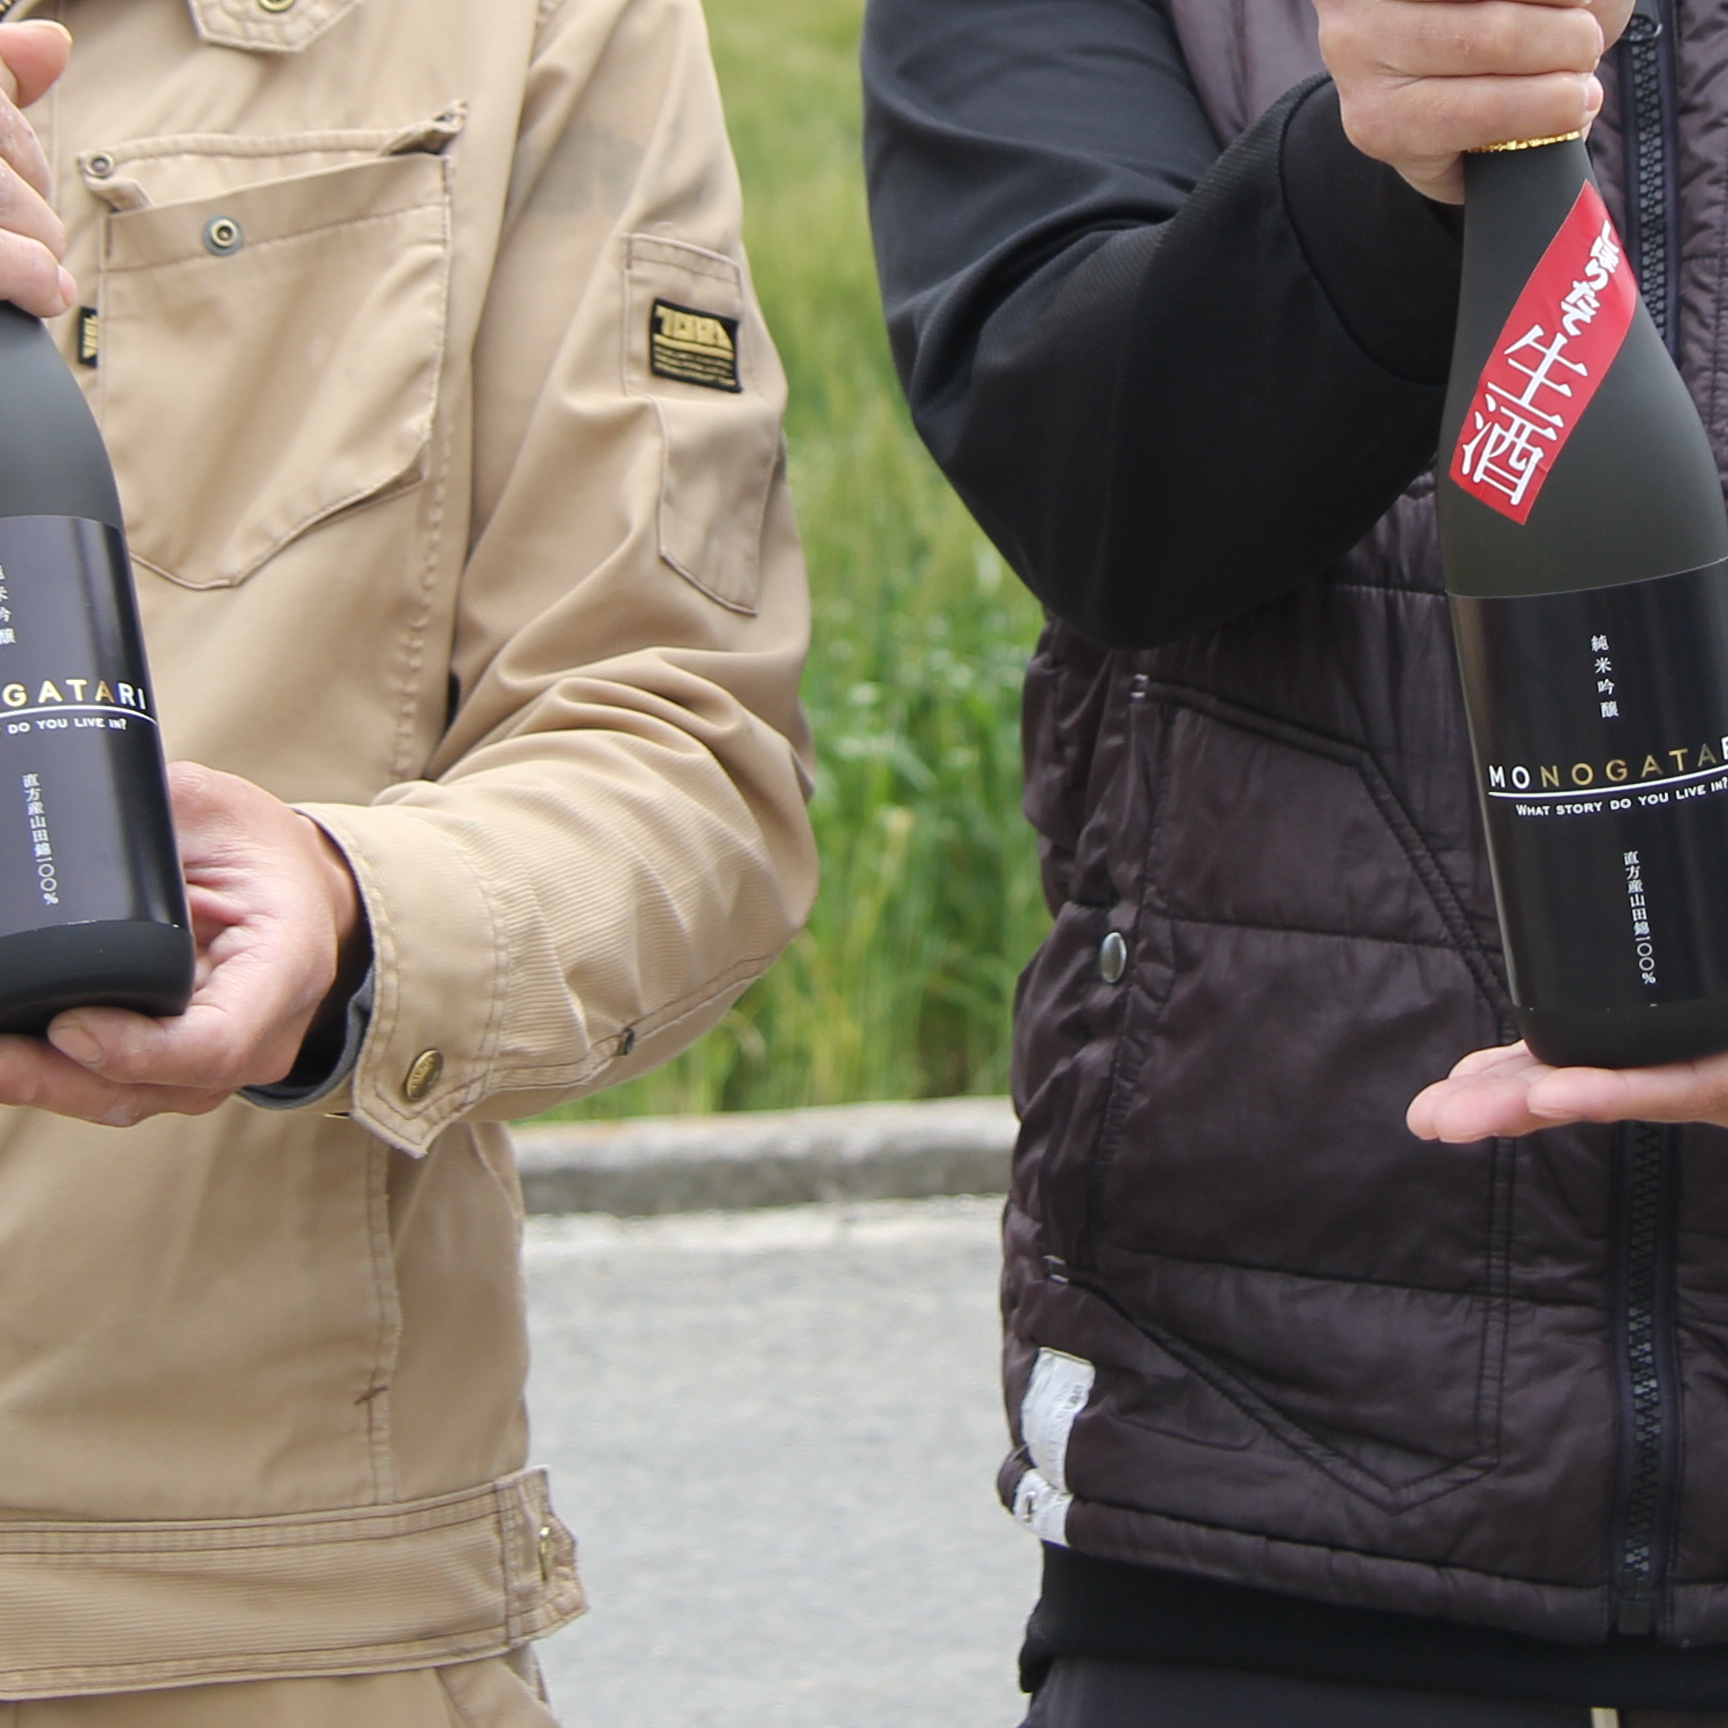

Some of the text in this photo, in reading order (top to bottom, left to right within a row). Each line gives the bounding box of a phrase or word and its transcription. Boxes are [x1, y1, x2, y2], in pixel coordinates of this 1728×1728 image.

[1591, 634, 1619, 719] 純米吟醸
[8, 722, 30, 736] DO
[36, 718, 68, 731] YOU
[74, 718, 105, 729] LIVE
[1556, 801, 1603, 816] STORY
[1610, 798, 1632, 811] DO
[1637, 792, 1669, 807] YOU
[1675, 784, 1707, 801] LIVE
[1711, 776, 1728, 794] IN?
